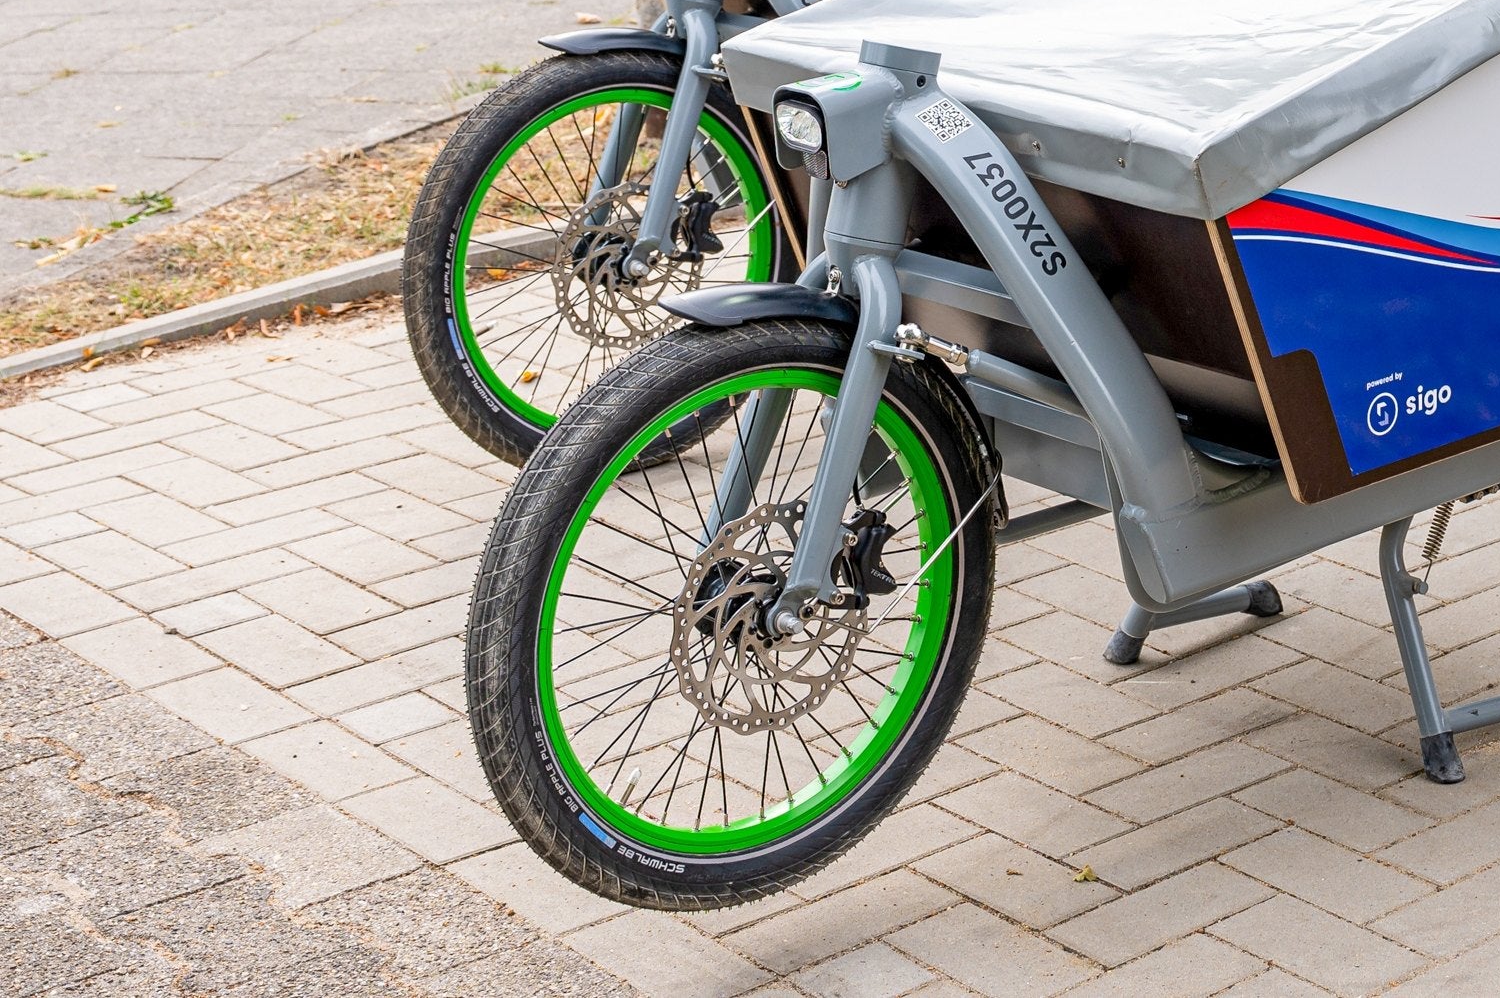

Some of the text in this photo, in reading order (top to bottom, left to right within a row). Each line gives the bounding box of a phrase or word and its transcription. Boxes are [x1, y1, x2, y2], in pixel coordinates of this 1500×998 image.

[962, 152, 1067, 276] S2X0037
[462, 363, 500, 413] SCHWALBE
[1366, 372, 1403, 391] powered by
[1406, 385, 1452, 415] sigo
[535, 731, 579, 813] BIG APPLE PLUS
[617, 845, 686, 874] SCHWALBE
